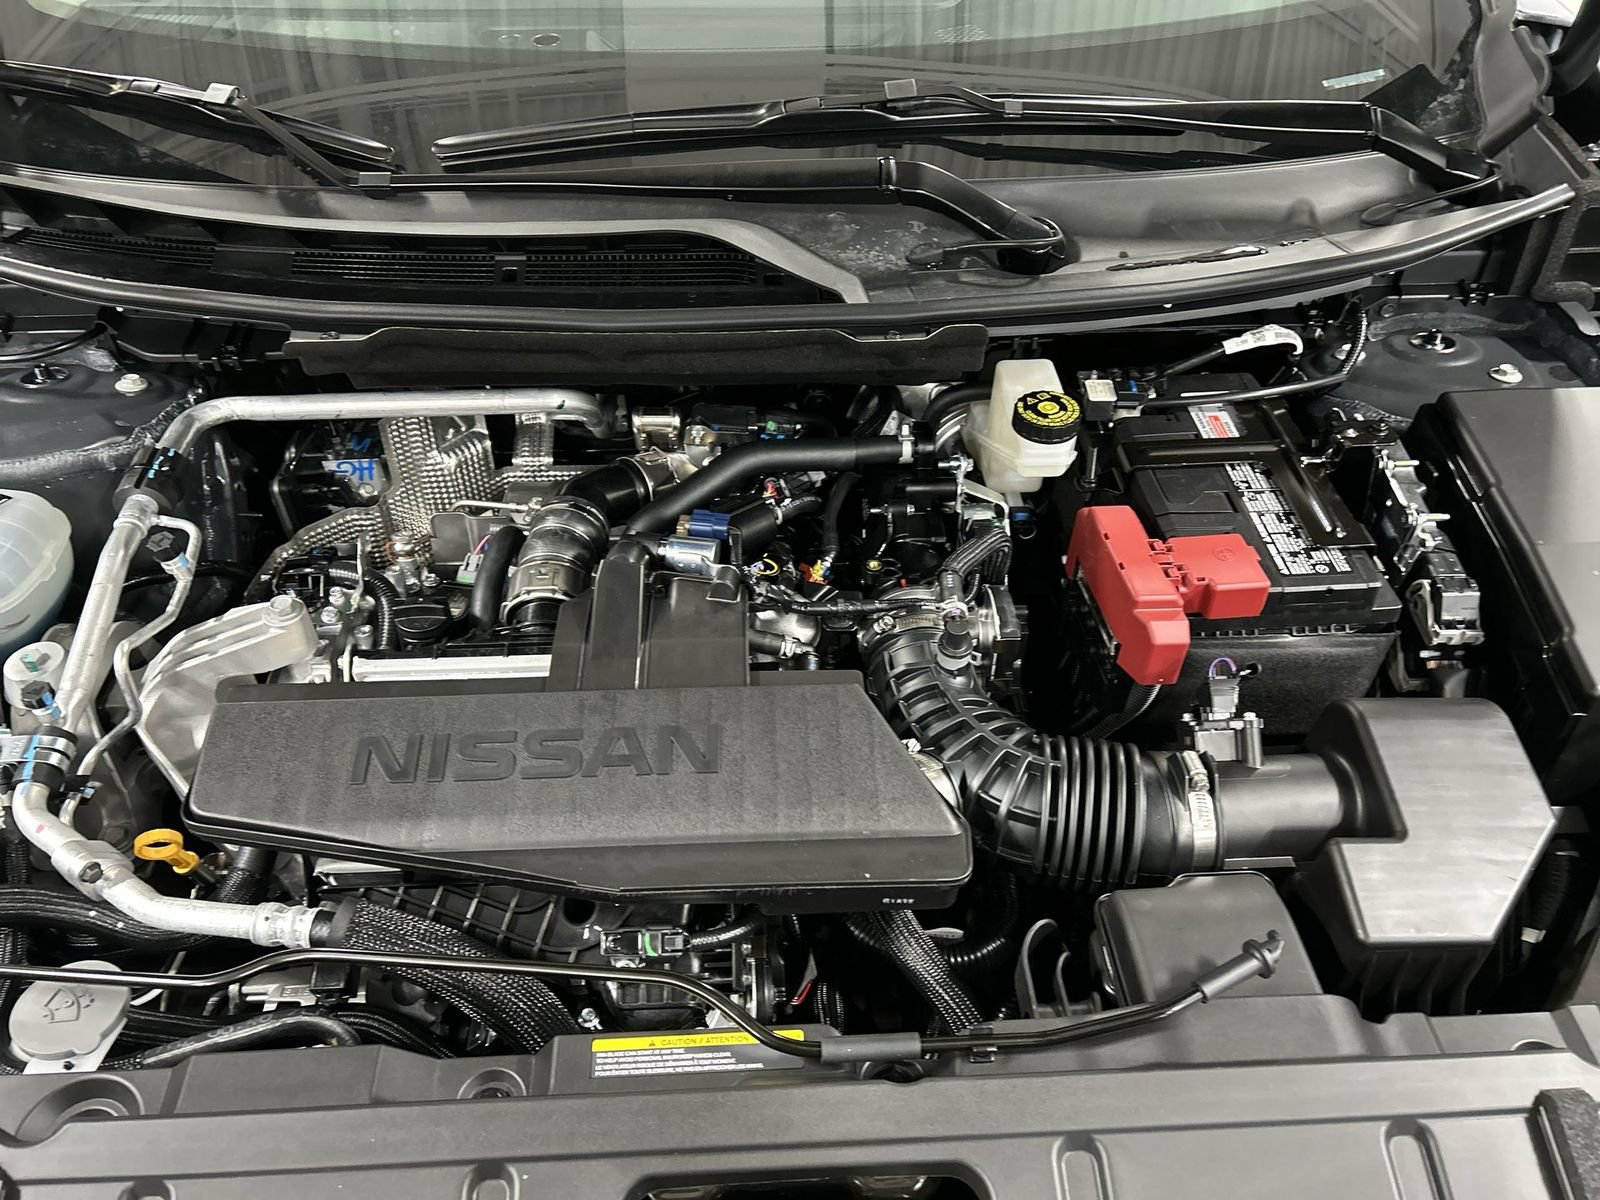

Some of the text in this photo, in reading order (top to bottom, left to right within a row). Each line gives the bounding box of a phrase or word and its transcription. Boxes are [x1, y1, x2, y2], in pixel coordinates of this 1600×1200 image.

[349, 723, 720, 786] NISSAN
[660, 1038, 697, 1047] CAUTION
[705, 1035, 749, 1044] ATTENTION
